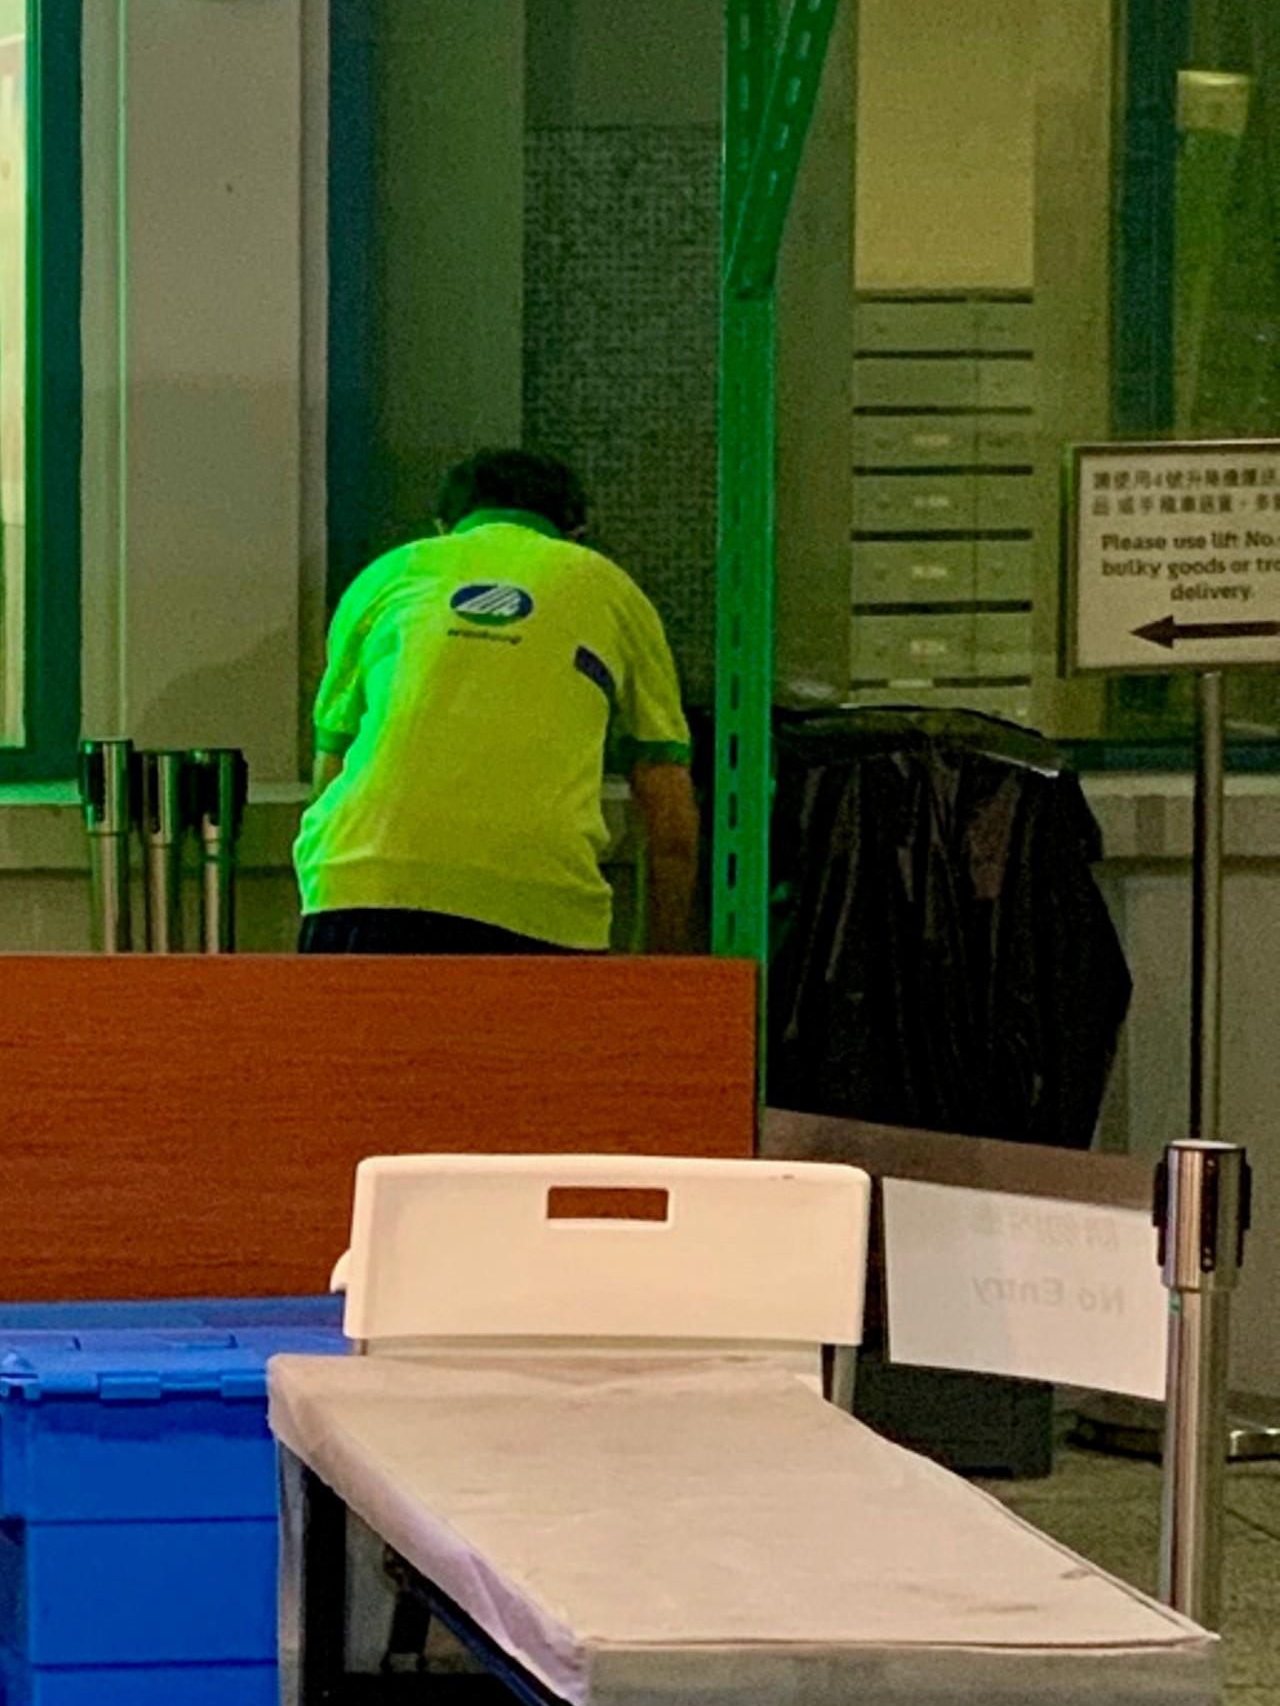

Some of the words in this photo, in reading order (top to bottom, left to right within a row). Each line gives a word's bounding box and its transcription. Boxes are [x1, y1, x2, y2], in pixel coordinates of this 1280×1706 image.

[1100, 532, 1167, 551] Please
[1172, 535, 1207, 550] use
[1211, 530, 1239, 549] lift
[1101, 559, 1162, 579] bulky
[1167, 557, 1226, 581] goods
[1230, 559, 1250, 574] or
